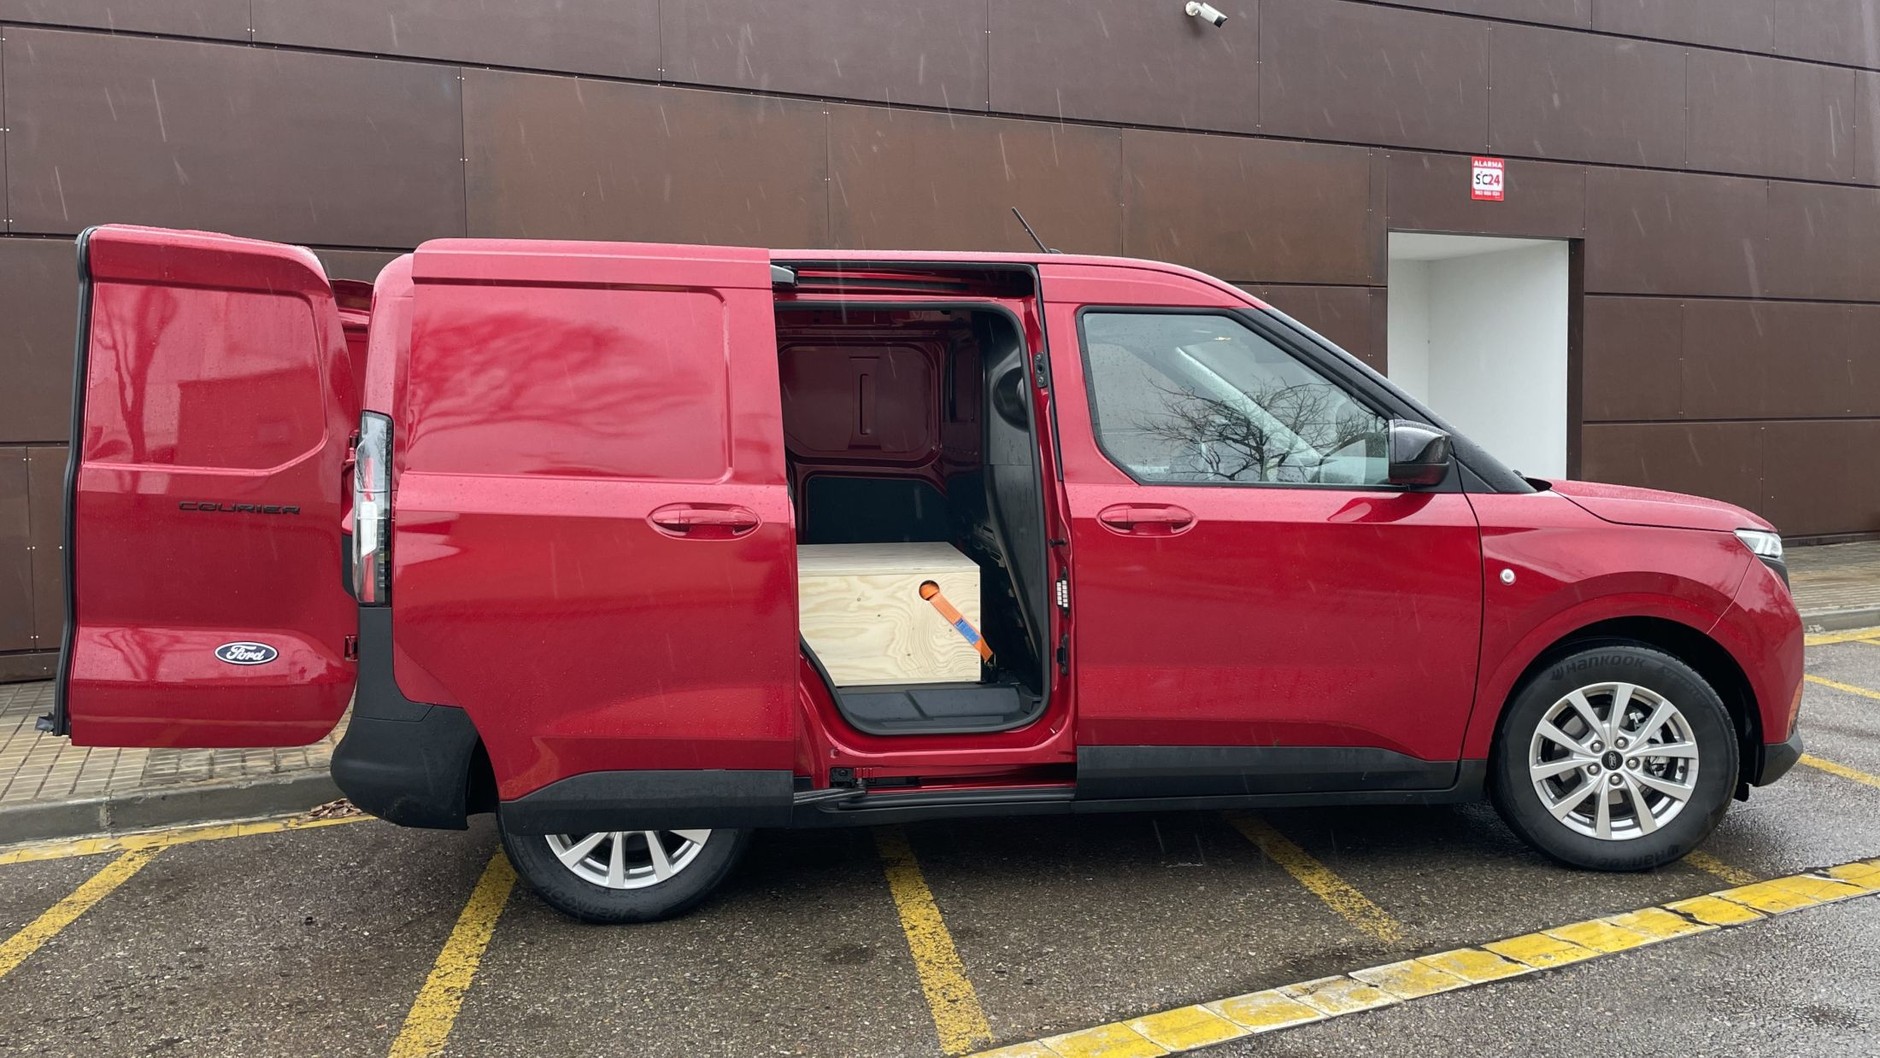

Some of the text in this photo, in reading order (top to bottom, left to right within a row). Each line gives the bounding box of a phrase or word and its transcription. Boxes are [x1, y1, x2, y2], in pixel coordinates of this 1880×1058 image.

[1474, 160, 1503, 168] ALARMA
[179, 501, 300, 515] COURIER
[226, 645, 266, 660] Ford
